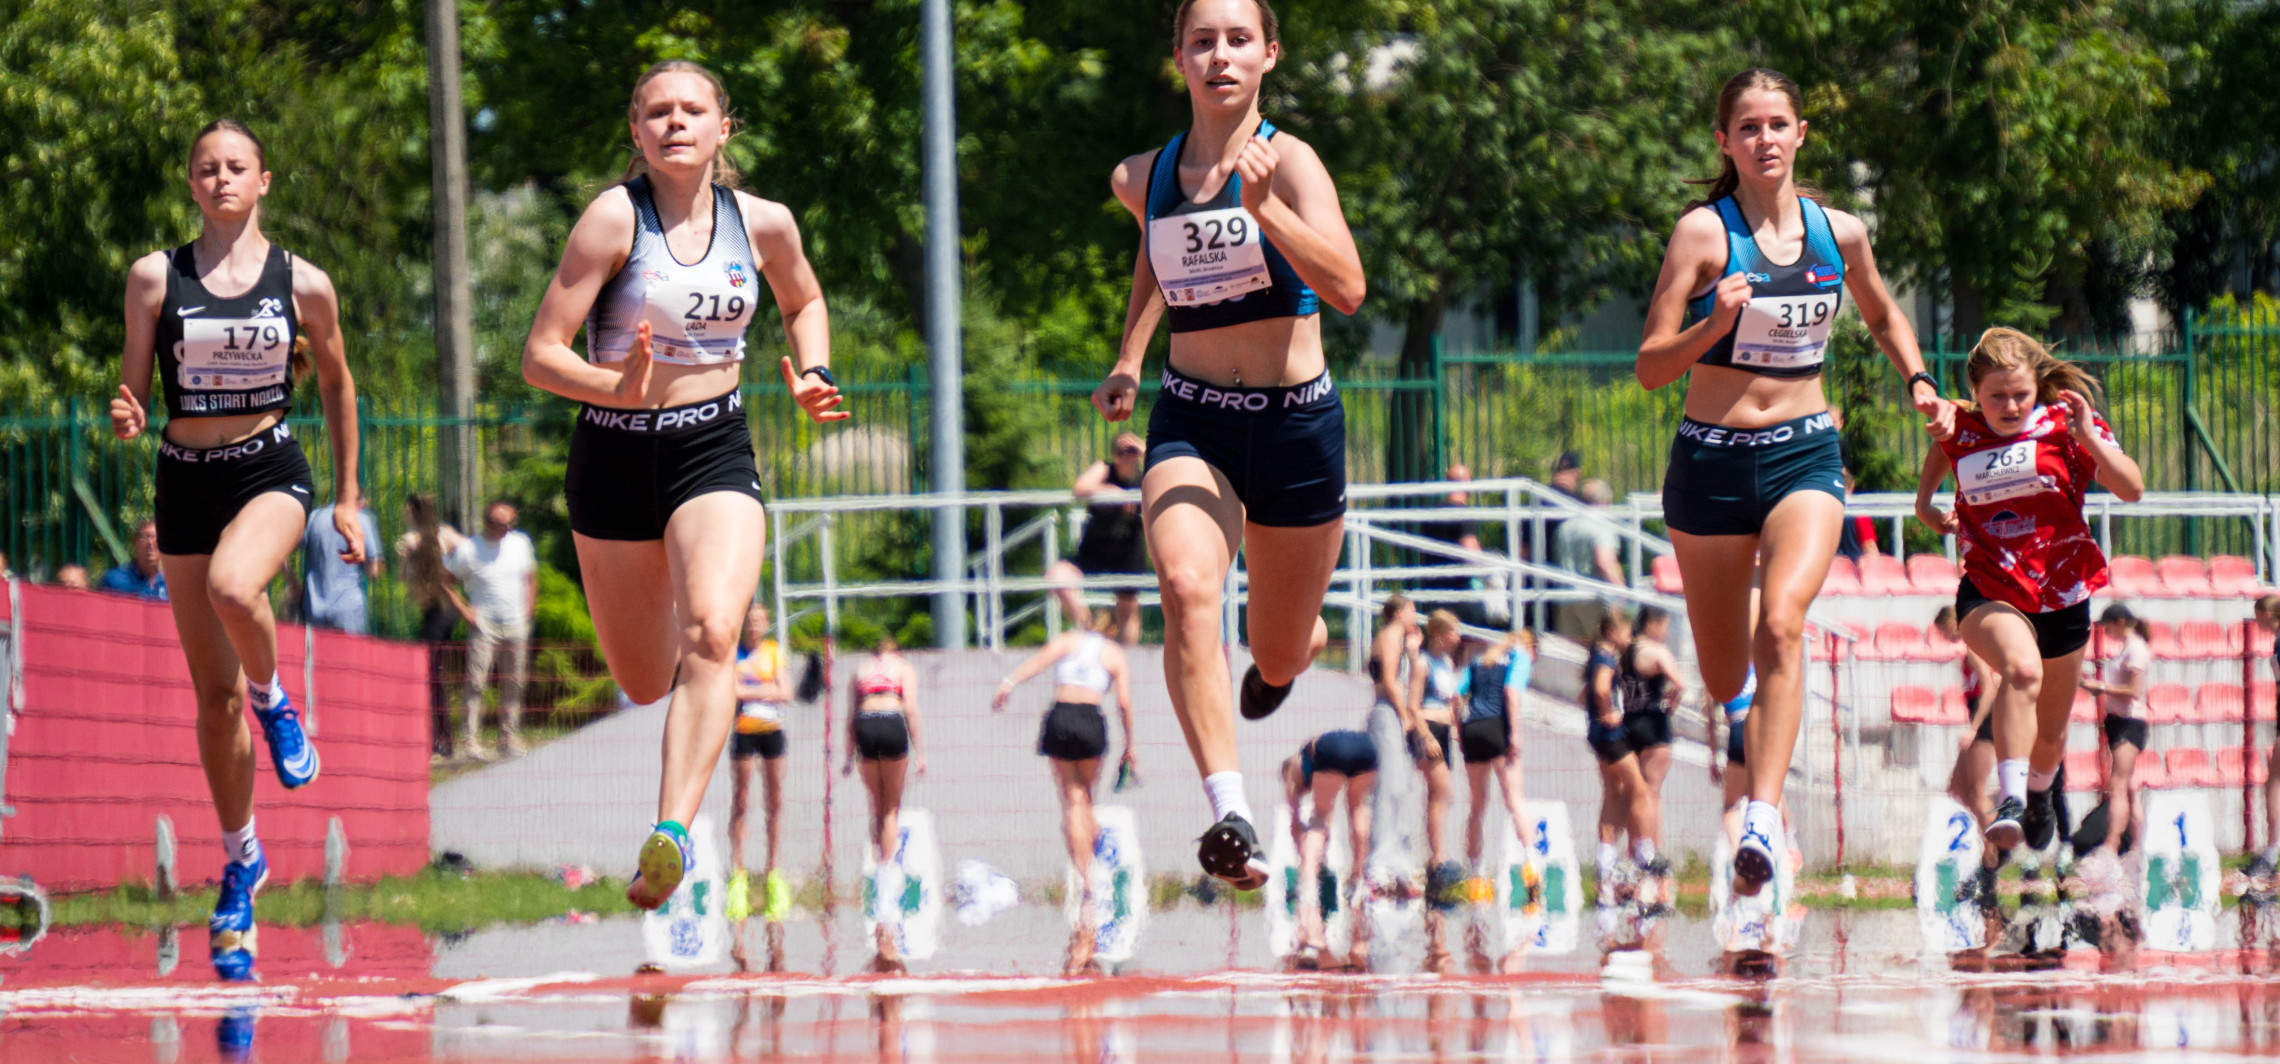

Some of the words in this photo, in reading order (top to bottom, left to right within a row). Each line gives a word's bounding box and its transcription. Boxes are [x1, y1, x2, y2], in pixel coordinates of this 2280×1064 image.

[1182, 216, 1248, 253] 329
[1181, 250, 1228, 268] RAFALSKA
[684, 292, 745, 322] 219
[1777, 301, 1829, 329] 319
[223, 325, 280, 351] 179
[212, 351, 263, 361] PRZYWECKA
[208, 393, 247, 410] START
[1200, 388, 1268, 411] PRO
[584, 407, 651, 431] NIKE
[655, 403, 719, 431] PRO
[1728, 426, 1794, 446] PRO
[204, 438, 265, 463] PRO
[1985, 446, 2027, 471] 263
[1975, 466, 2020, 481] MARCHLEWICZ
[1948, 811, 1972, 851] 2
[2173, 811, 2187, 848] 1
